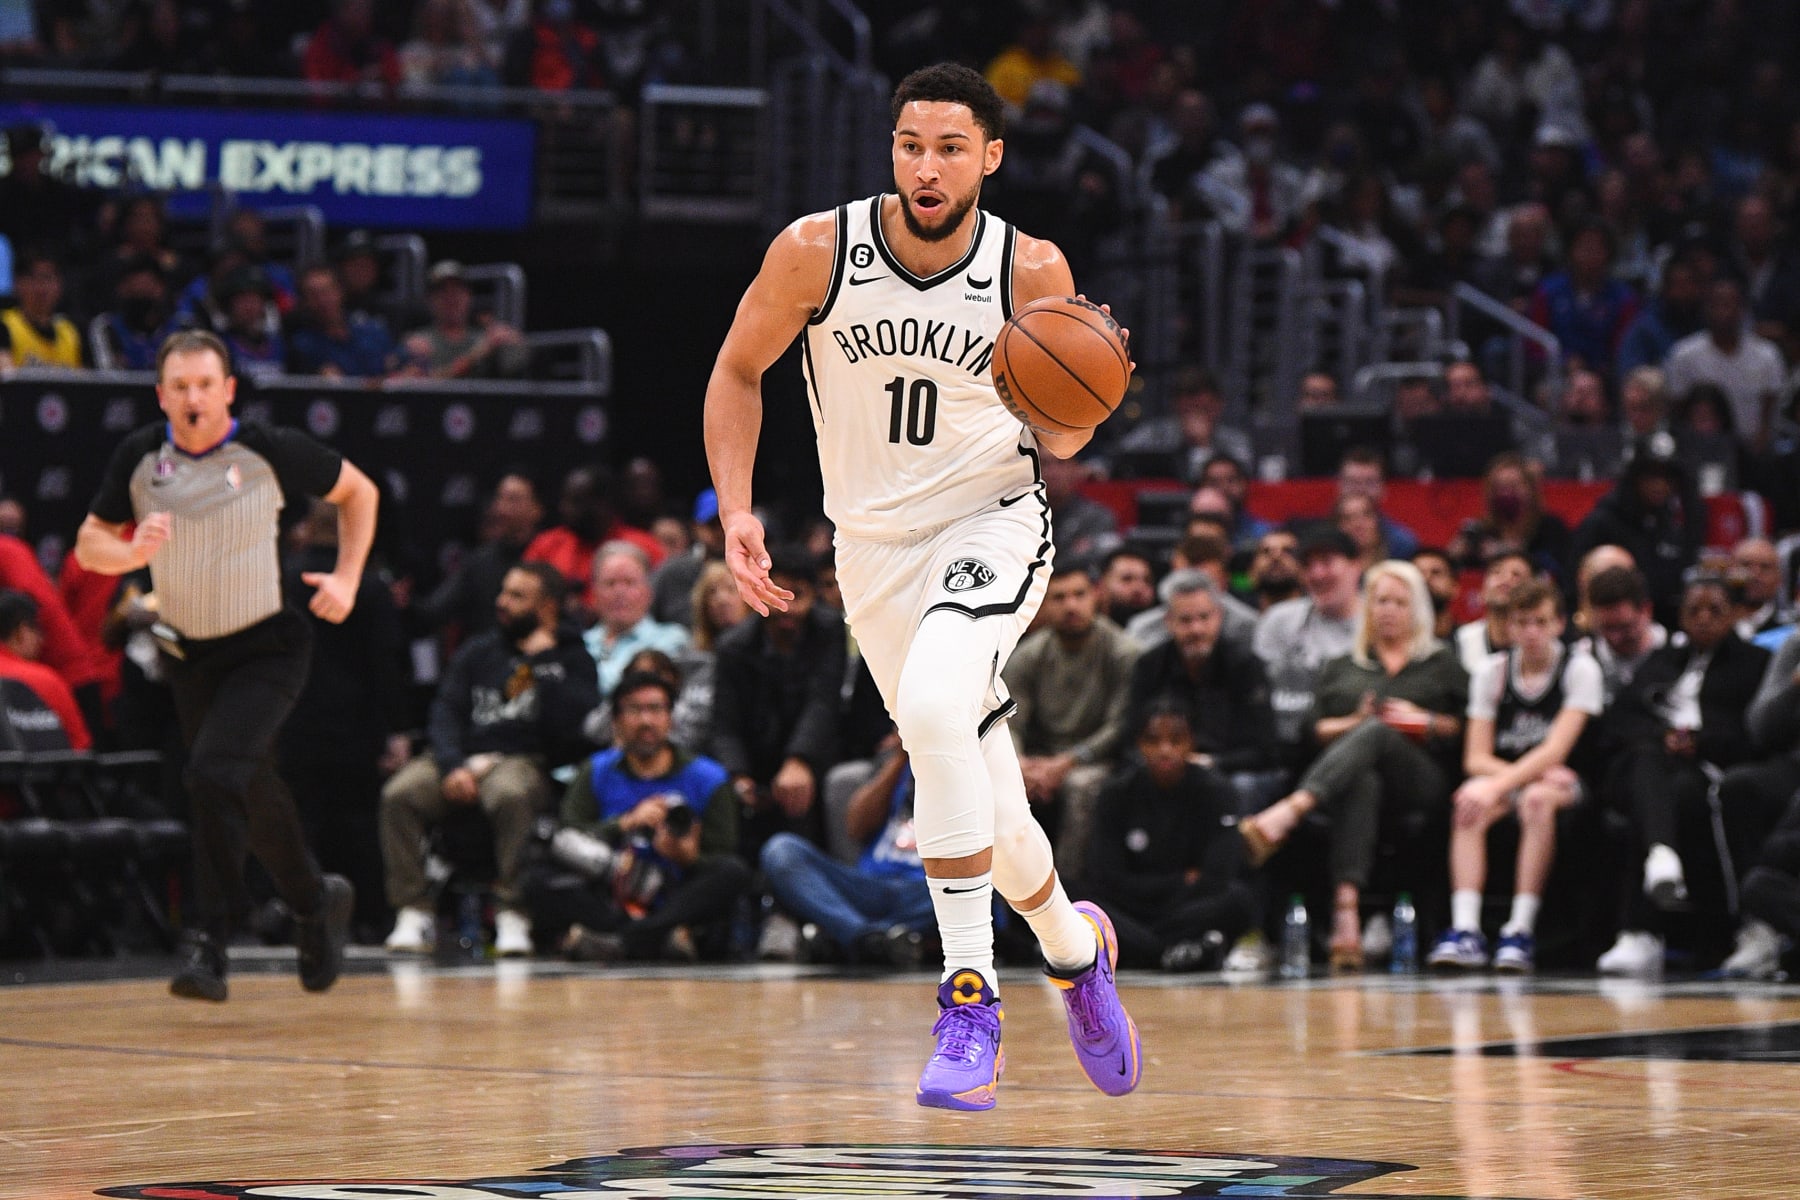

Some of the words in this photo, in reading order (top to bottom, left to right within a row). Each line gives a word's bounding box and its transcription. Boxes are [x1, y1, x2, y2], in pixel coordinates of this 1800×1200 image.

[219, 140, 482, 197] EXPRESS
[855, 247, 869, 266] 6
[964, 293, 992, 303] Webull
[832, 318, 994, 377] BROOKLYN
[884, 376, 938, 446] 10
[946, 560, 992, 582] NETS
